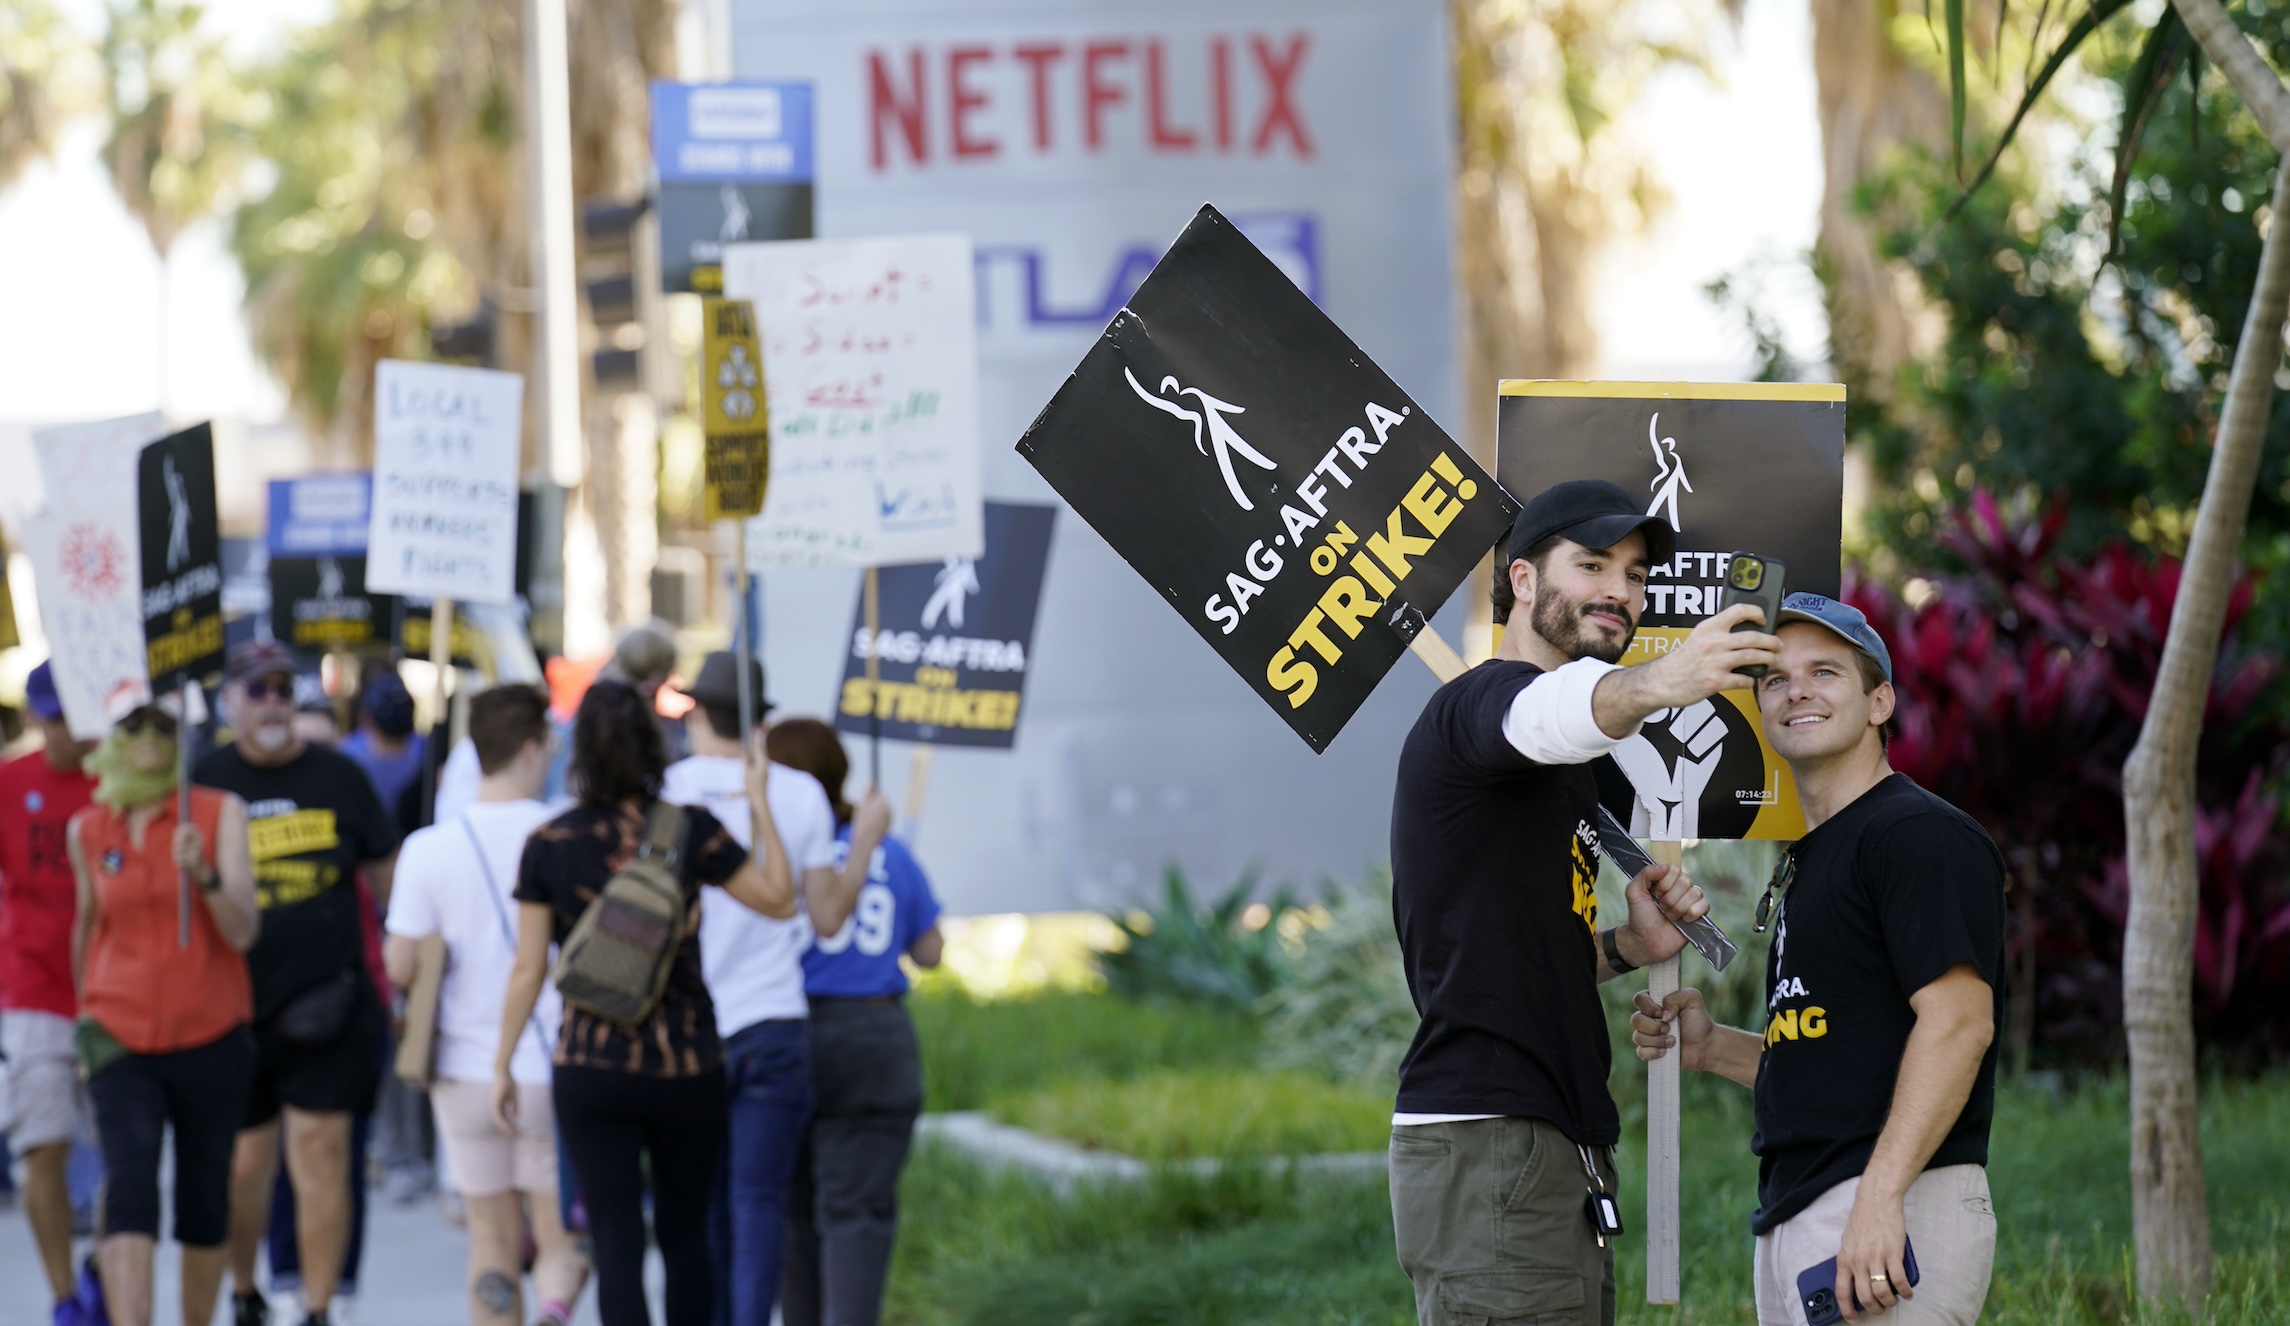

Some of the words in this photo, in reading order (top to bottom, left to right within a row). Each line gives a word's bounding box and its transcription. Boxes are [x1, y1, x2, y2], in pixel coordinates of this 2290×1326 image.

[866, 28, 1316, 171] NETFLIX
[1310, 520, 1359, 576] ON
[1649, 551, 1750, 578] AFTR
[1266, 451, 1478, 710] STRIKE!
[1643, 584, 1725, 615] TRI
[853, 627, 1026, 672] SAG·AFTRA
[1627, 636, 1684, 653] FTRA
[915, 665, 958, 688] ON
[1735, 789, 1773, 799] 07:14:23
